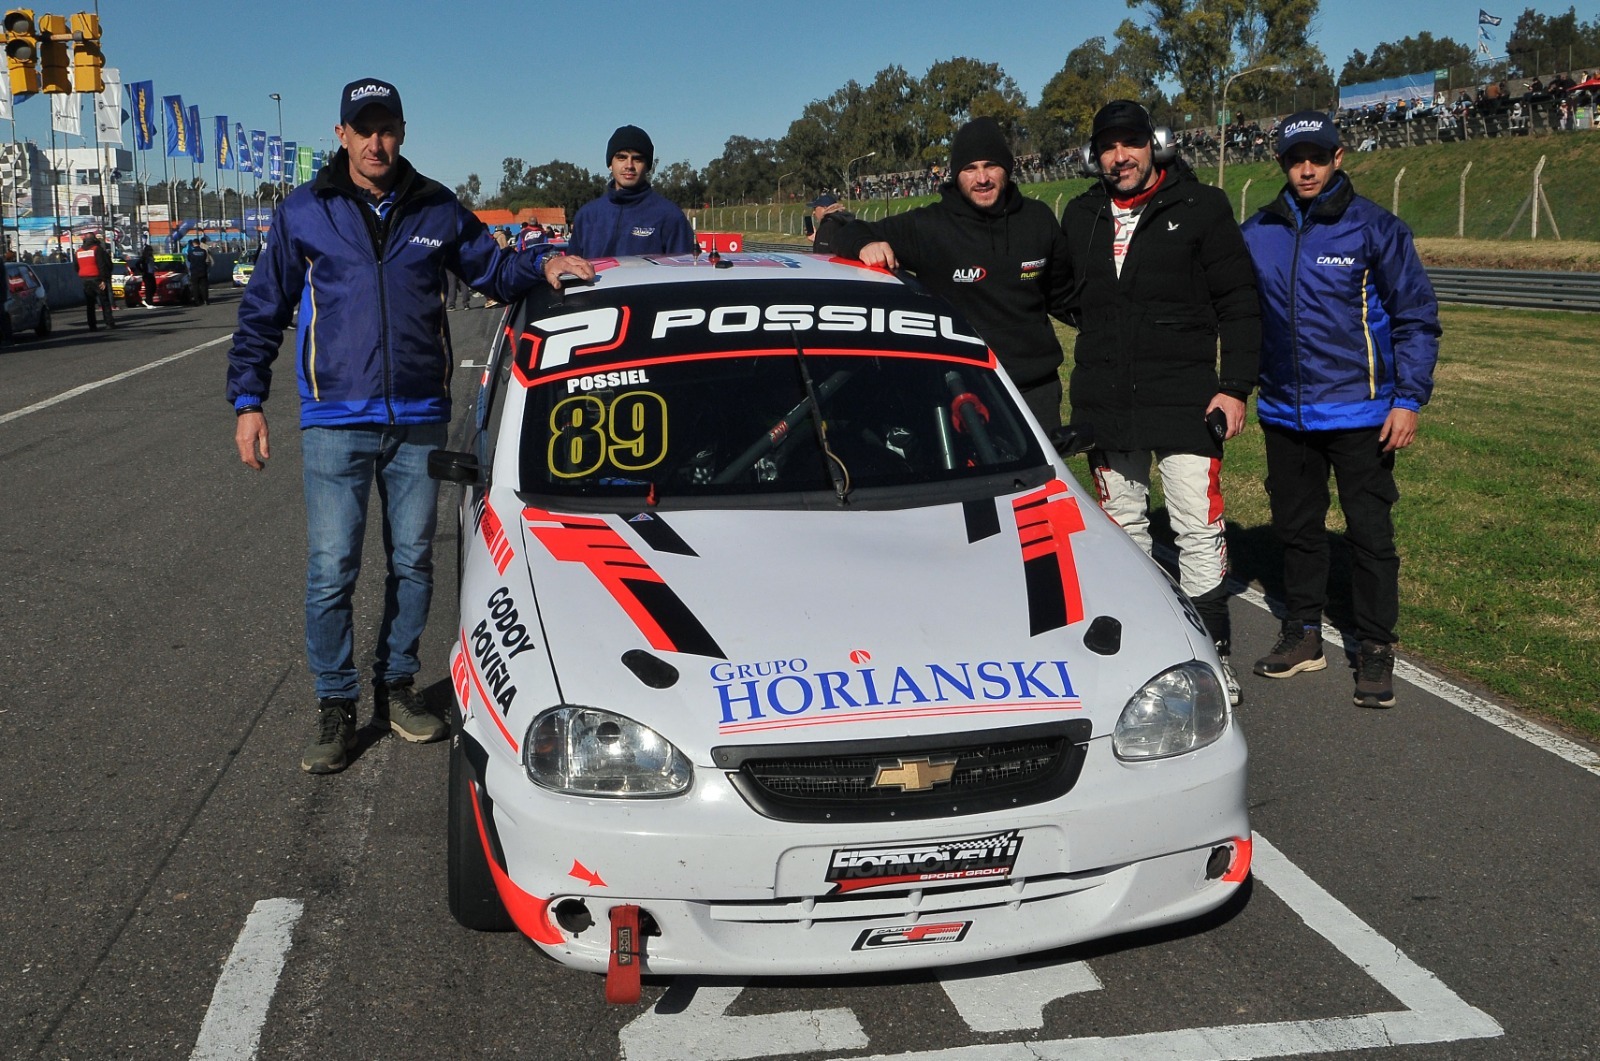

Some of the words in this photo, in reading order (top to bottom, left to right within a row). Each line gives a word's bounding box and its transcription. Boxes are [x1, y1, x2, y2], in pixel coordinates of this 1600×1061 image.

[1285, 120, 1323, 133] CAMAV
[210, 220, 232, 228] RUS
[1317, 256, 1355, 265] CAMAV
[952, 268, 981, 279] ALM
[651, 304, 986, 346] POSSIEL
[567, 369, 650, 394] POSSIEL
[547, 390, 668, 479] 89
[487, 586, 536, 660] GODOY
[470, 618, 518, 719] POVIÑA
[710, 657, 809, 683] GRUPO
[713, 660, 1080, 724] HORIANSKI
[919, 871, 963, 880] SPORT
[965, 867, 1010, 876] GROUP
